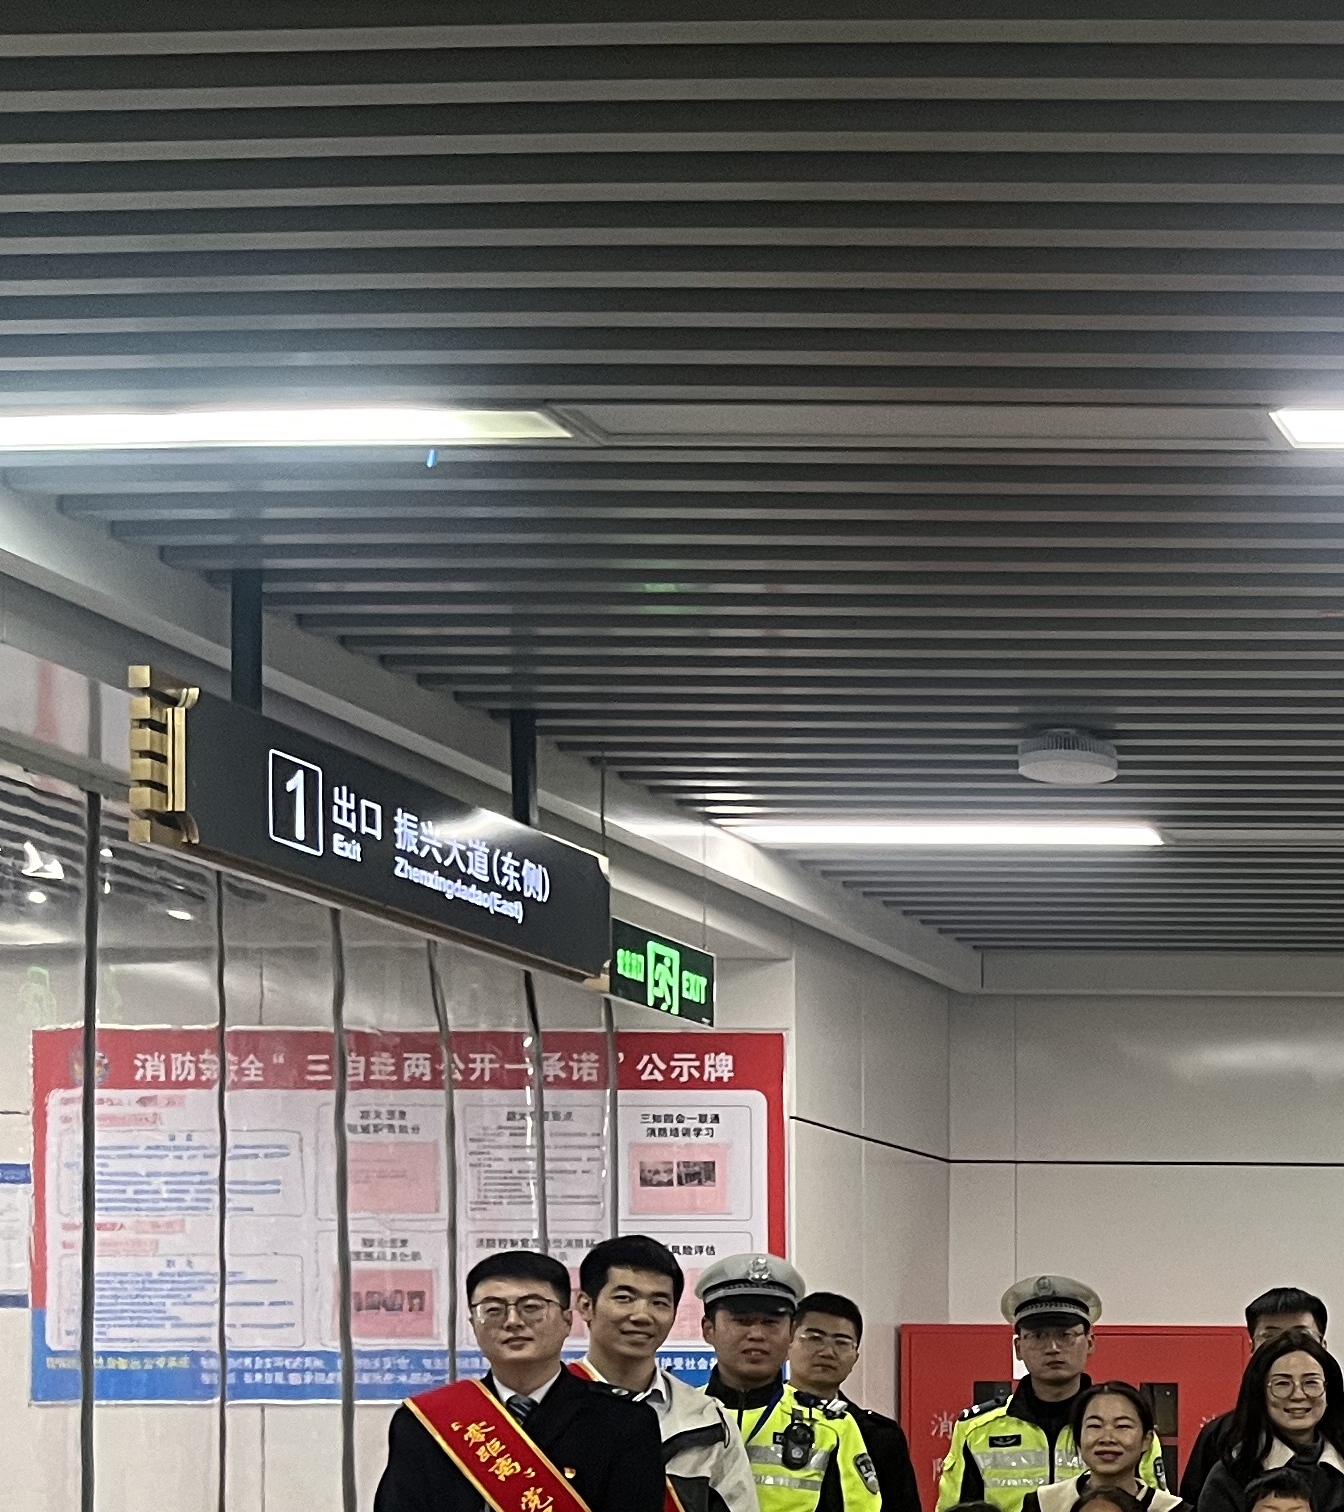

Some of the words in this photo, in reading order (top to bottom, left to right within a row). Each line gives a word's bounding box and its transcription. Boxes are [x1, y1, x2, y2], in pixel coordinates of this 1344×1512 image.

[285, 769, 306, 841] 1
[332, 785, 383, 840] 出口
[332, 832, 362, 862] Exit
[681, 970, 708, 1005] EXIT
